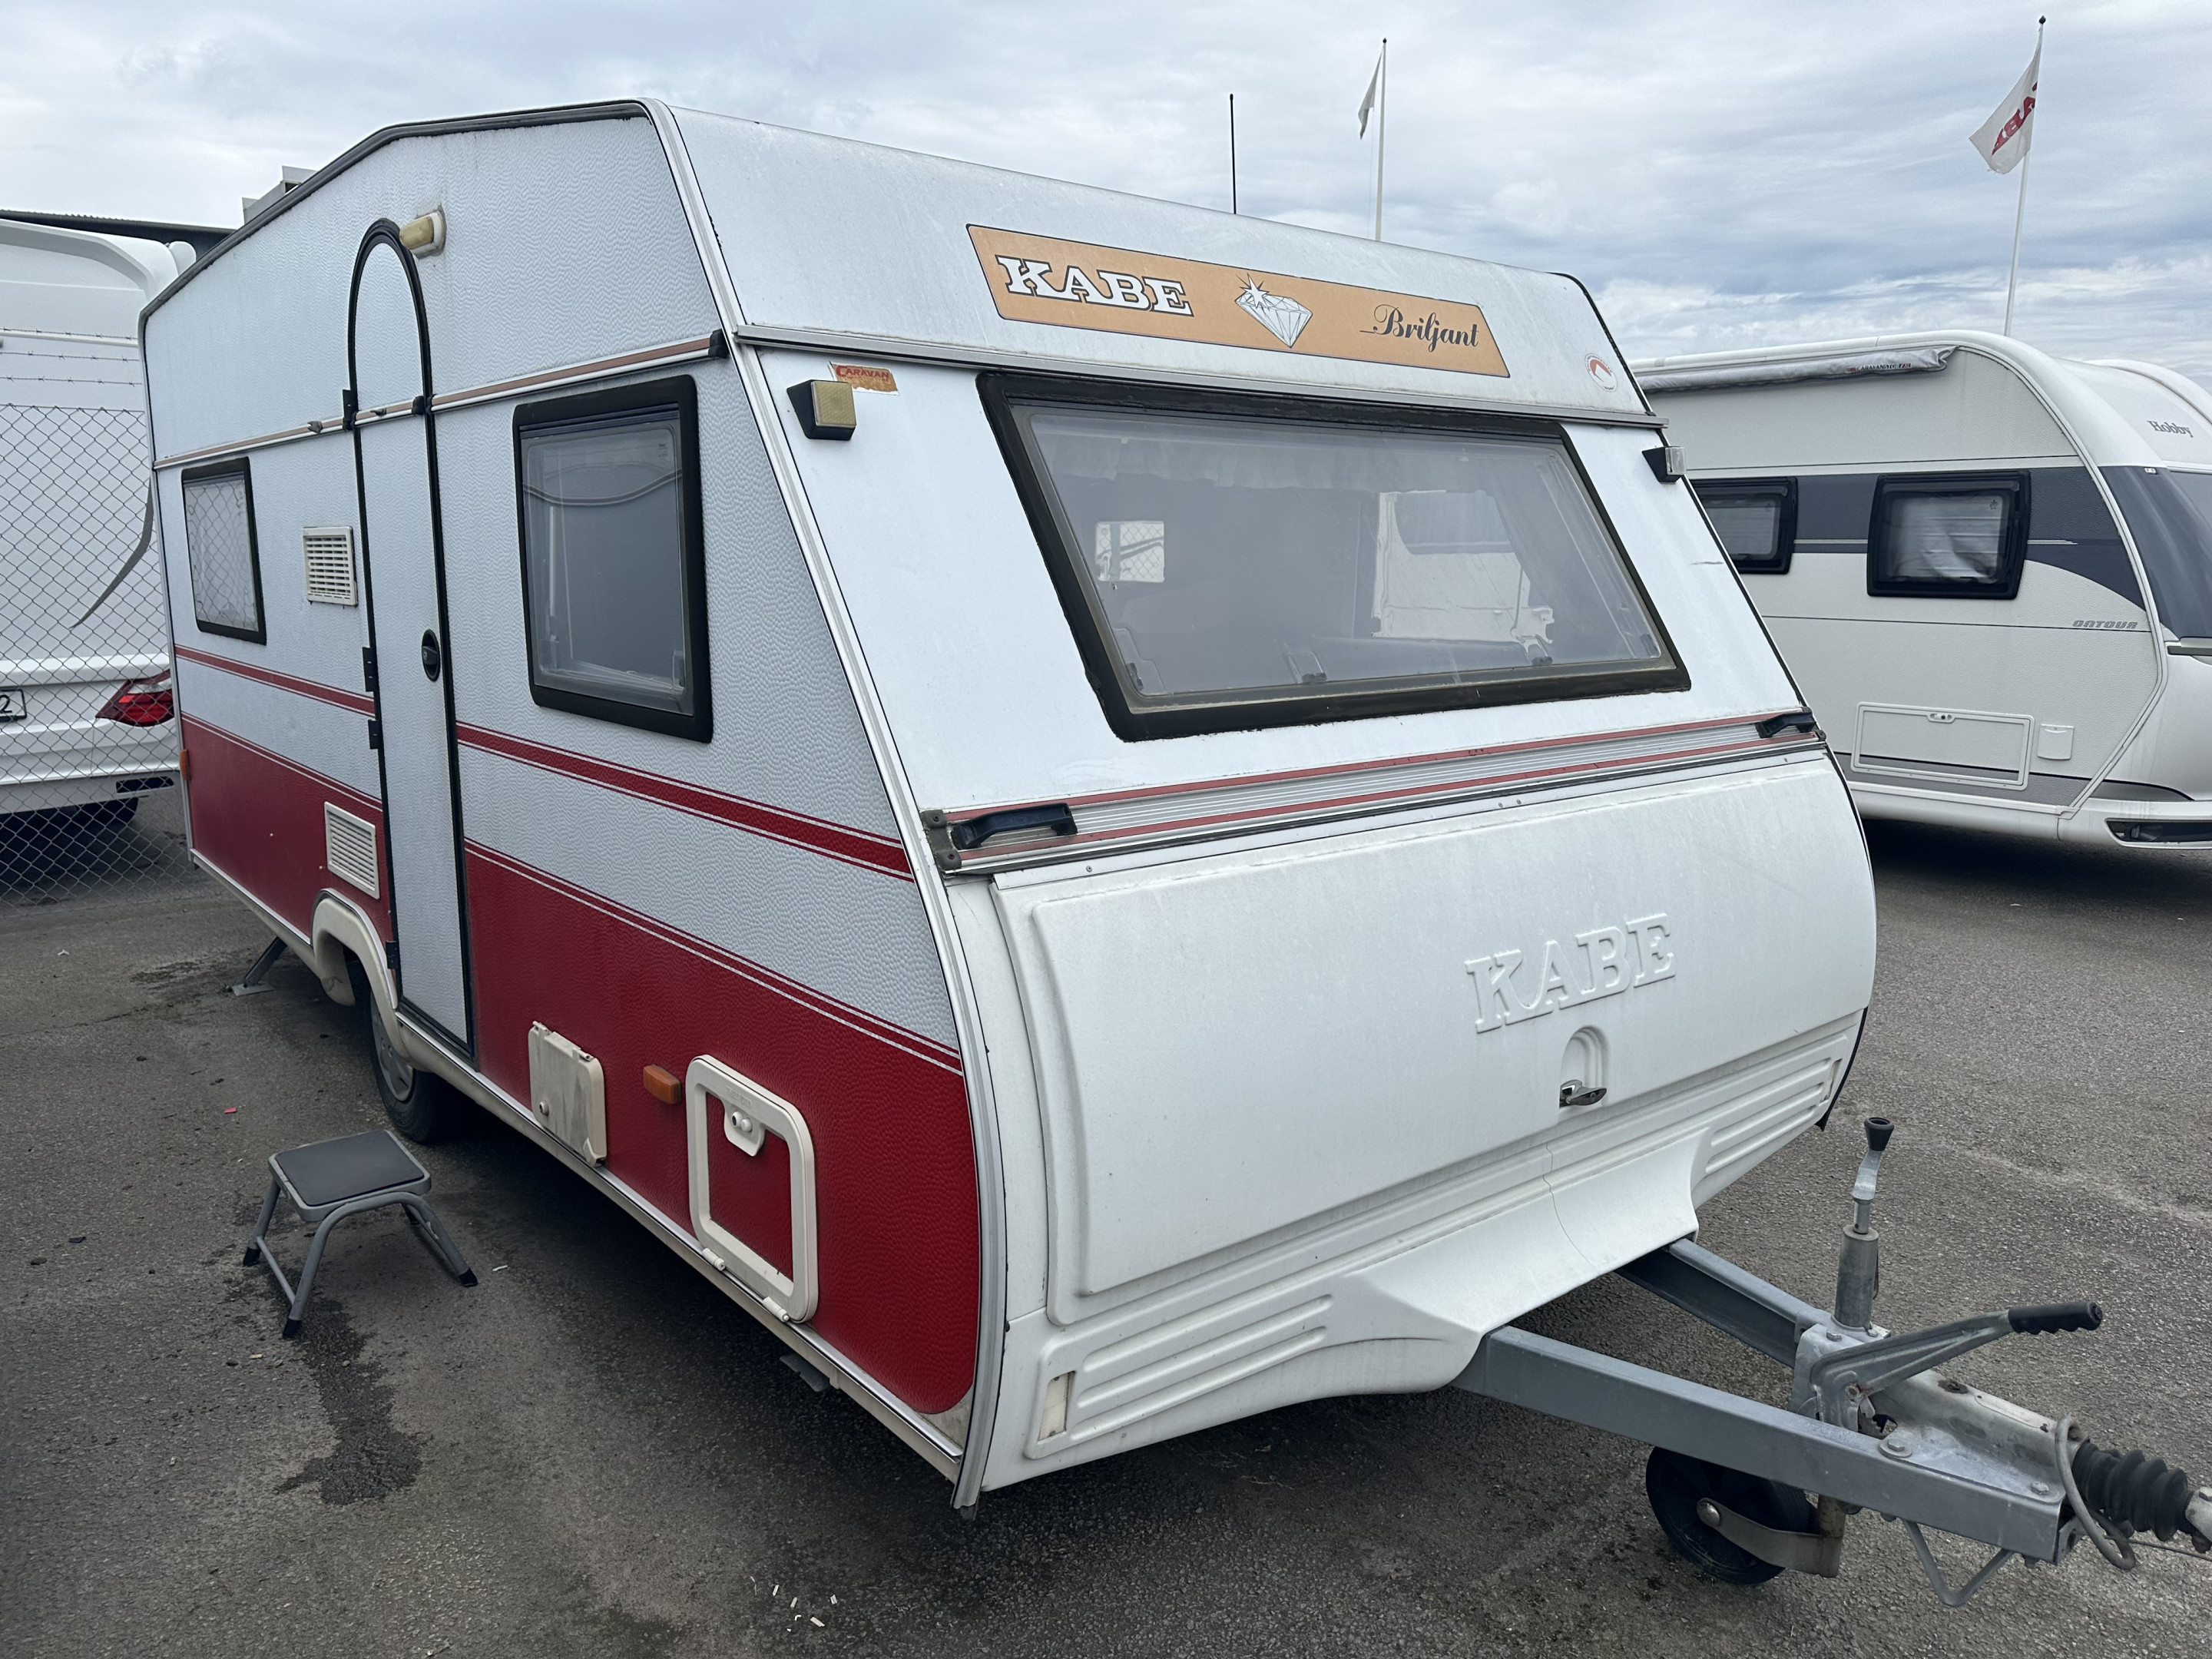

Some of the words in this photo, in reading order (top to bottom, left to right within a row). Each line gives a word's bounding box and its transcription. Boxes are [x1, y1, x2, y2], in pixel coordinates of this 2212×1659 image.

[995, 254, 1194, 317] KABE
[1359, 304, 1480, 353] Briljant
[2147, 420, 2194, 438] Hobby
[2072, 620, 2138, 629] ONTOUR
[1464, 912, 1676, 1035] KABE
